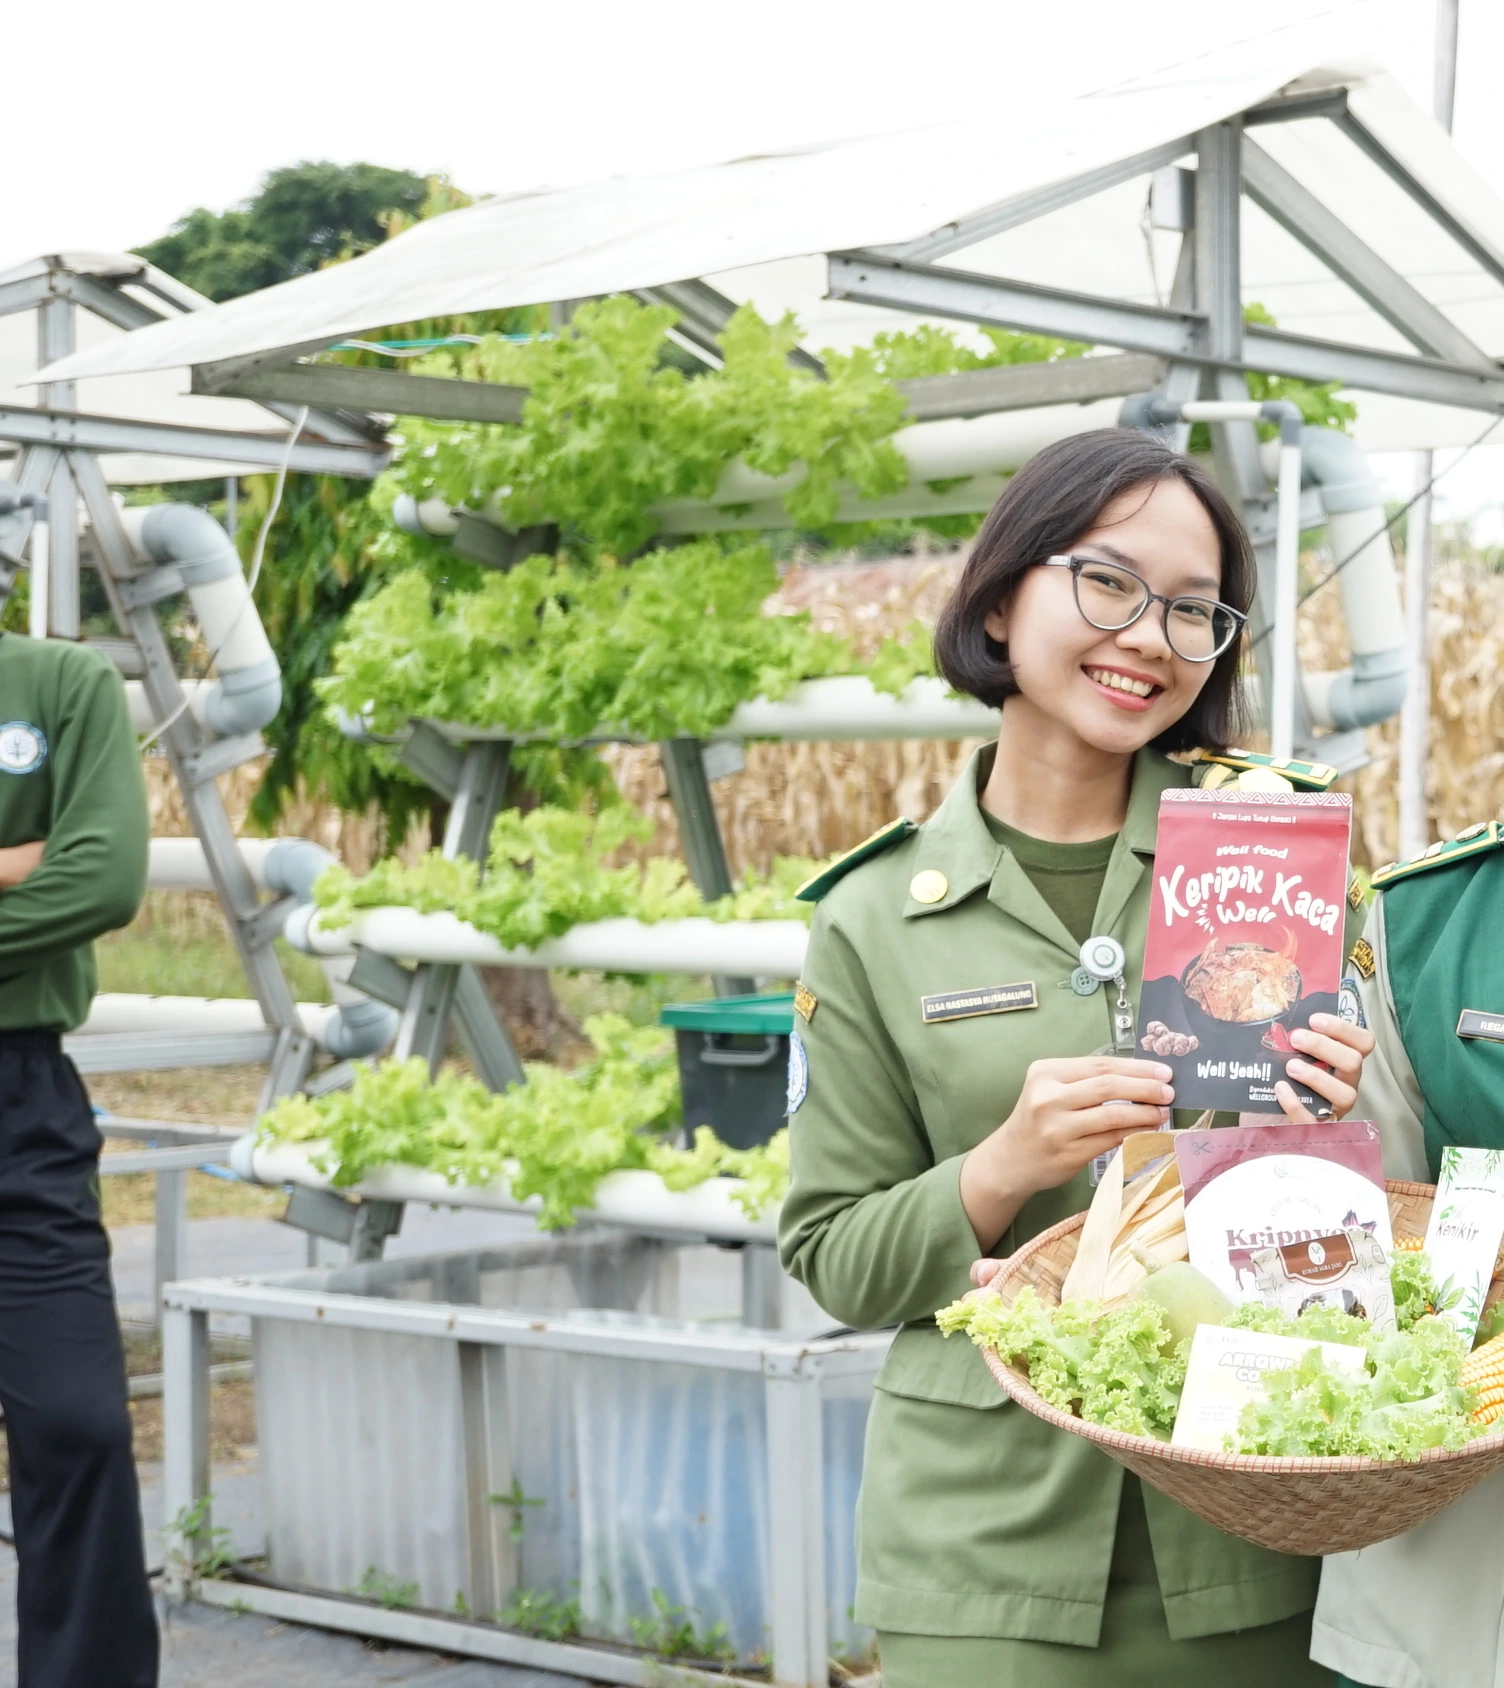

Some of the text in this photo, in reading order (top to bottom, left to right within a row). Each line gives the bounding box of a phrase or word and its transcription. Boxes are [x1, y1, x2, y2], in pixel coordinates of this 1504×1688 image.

[1252, 844, 1289, 860] food
[1159, 865, 1264, 927] Keripik
[1271, 872, 1340, 936] Kaca
[926, 1002, 946, 1013] ELSA
[1197, 1060, 1272, 1081] Well Yeah!!
[1436, 1220, 1479, 1242] Kenikir
